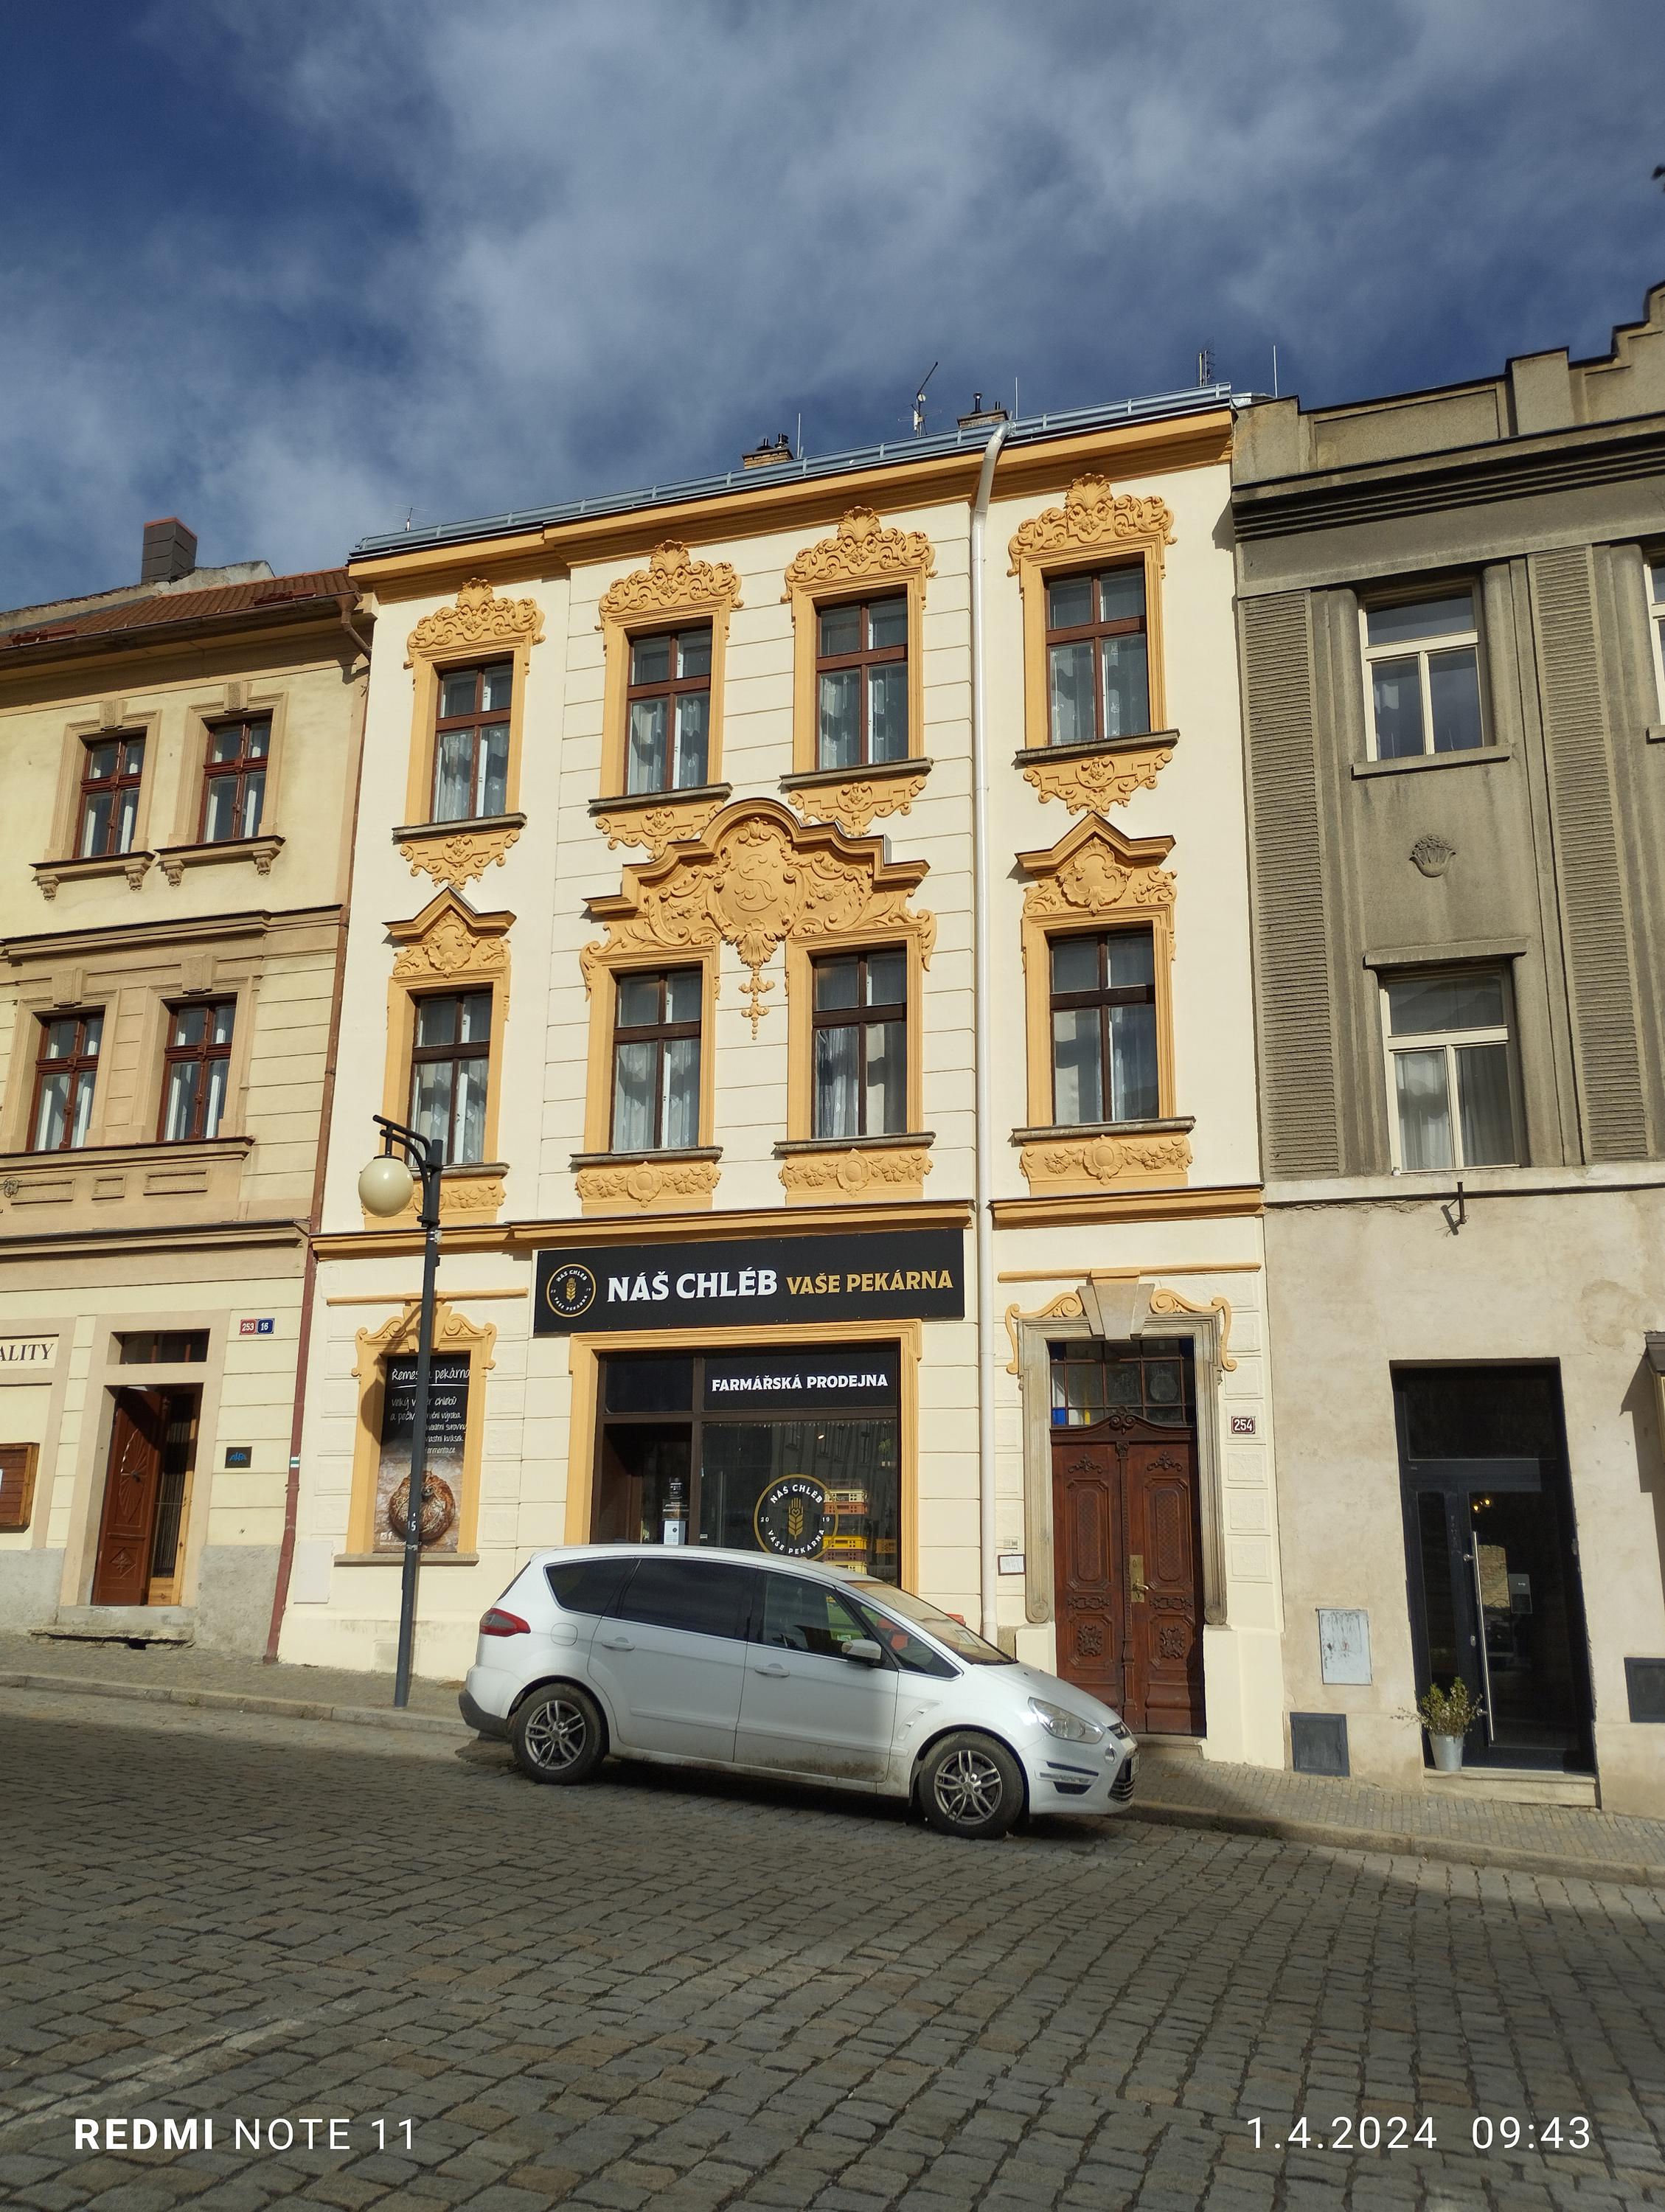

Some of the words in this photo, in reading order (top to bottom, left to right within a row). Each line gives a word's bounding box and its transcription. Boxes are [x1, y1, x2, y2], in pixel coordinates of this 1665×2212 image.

[607, 1270, 670, 1302] NÁŠ
[676, 1267, 778, 1299] CHLÉB
[786, 1273, 841, 1295] VAŠE
[847, 1269, 954, 1293] PEKÁRNA
[242, 1323, 254, 1332] 253
[260, 1322, 269, 1331] 16
[712, 1374, 802, 1392] FARMÁŘSKÁ
[807, 1374, 889, 1389] PRODEJNA
[1234, 1419, 1253, 1431] 254
